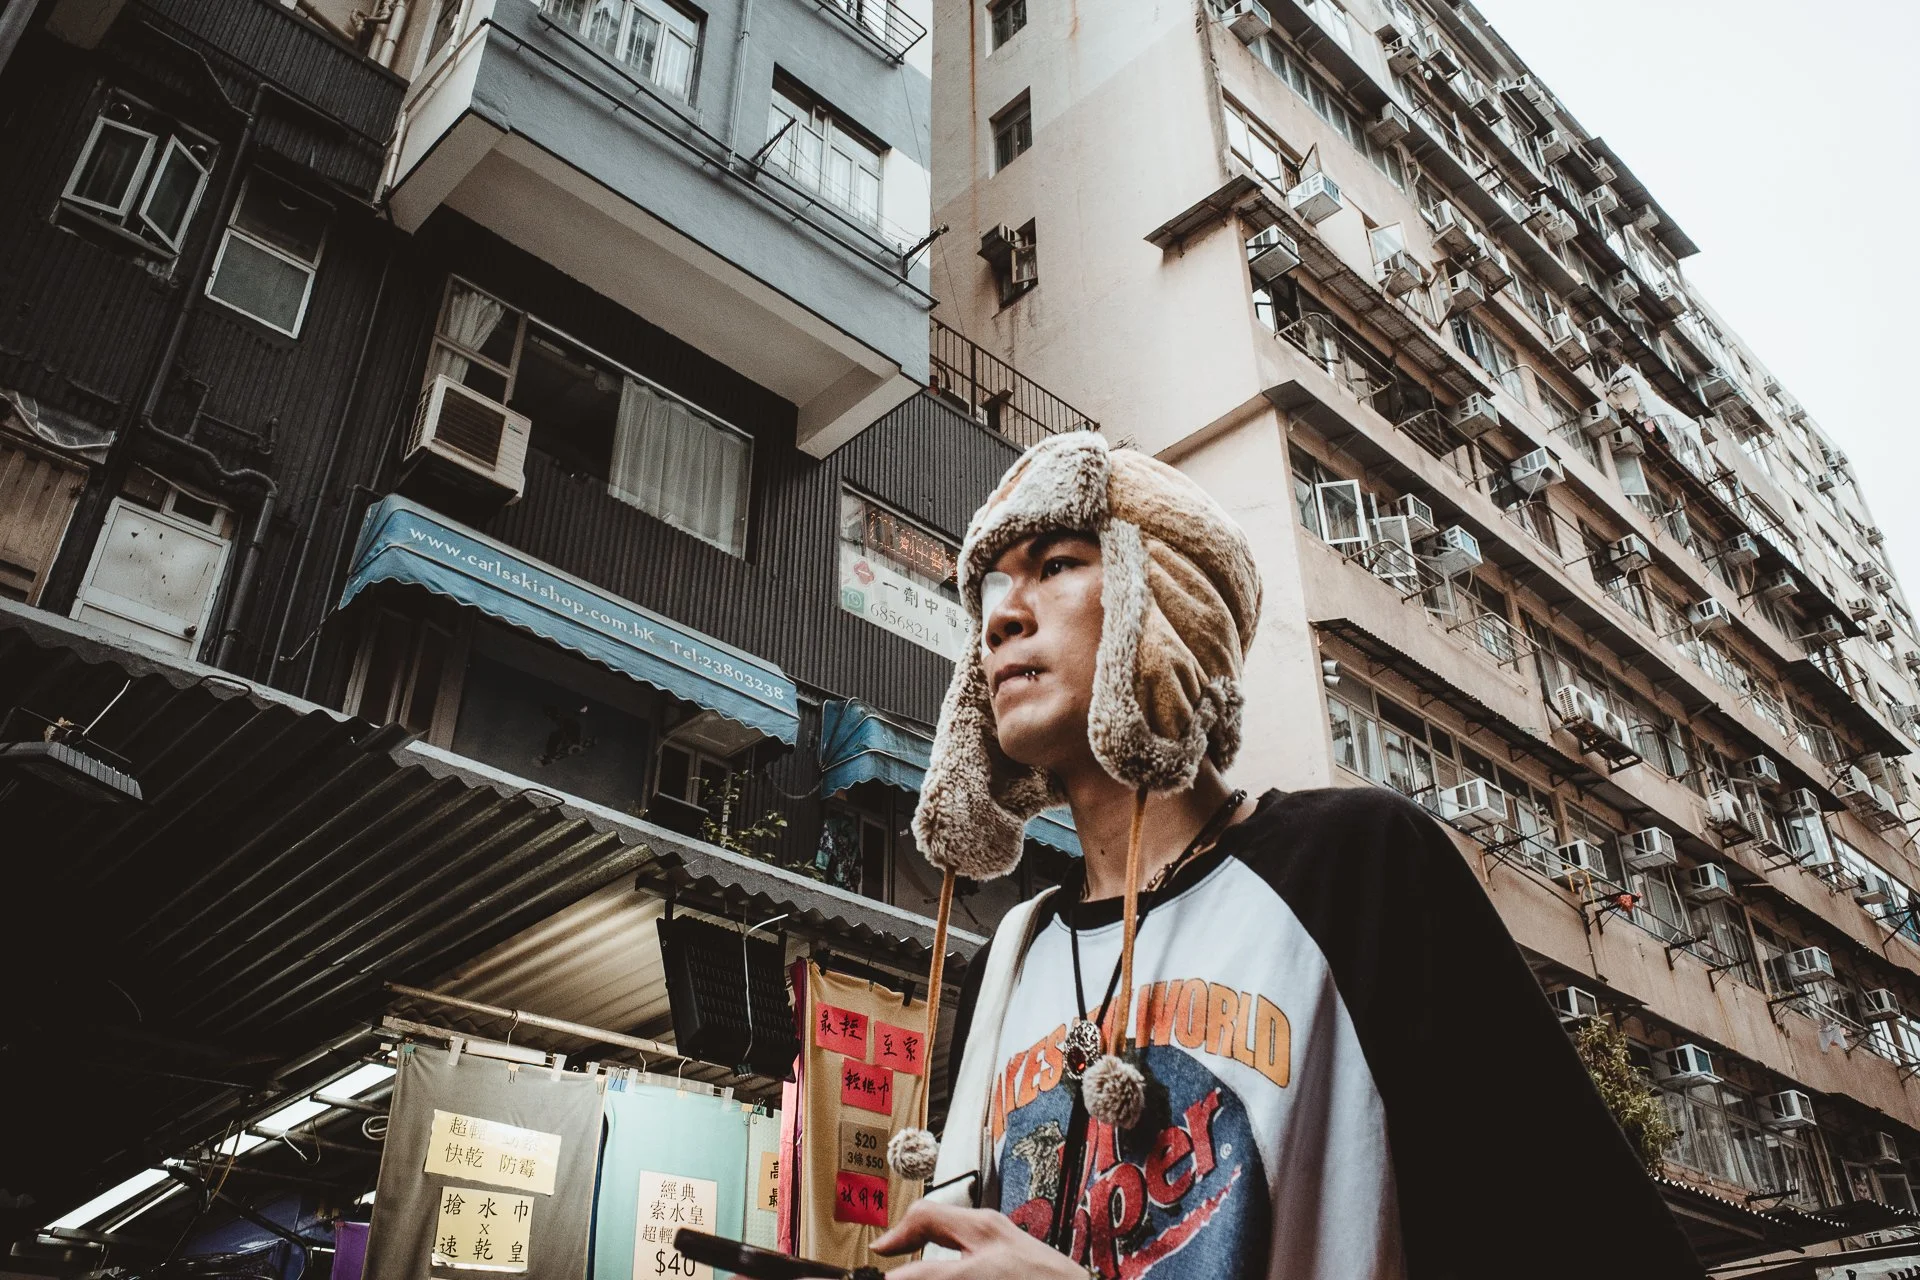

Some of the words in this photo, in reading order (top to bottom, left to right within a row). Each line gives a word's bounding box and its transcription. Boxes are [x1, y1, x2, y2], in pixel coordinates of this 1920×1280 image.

[410, 528, 654, 643] www.carlsskishop.com.hk
[670, 640, 784, 700] Tel:23803238
[870, 603, 941, 647] 68568214
[1136, 978, 1291, 1088] WORLD
[854, 1130, 877, 1150] $20
[445, 1142, 484, 1168] 快乾
[498, 1154, 536, 1178] 防霉
[866, 1154, 884, 1169] $50
[660, 1179, 696, 1203] 經典
[443, 1193, 528, 1223] 搶水巾
[650, 1199, 704, 1226] 索水皇
[439, 1235, 525, 1263] 速乾皇
[655, 1249, 696, 1277] $40
